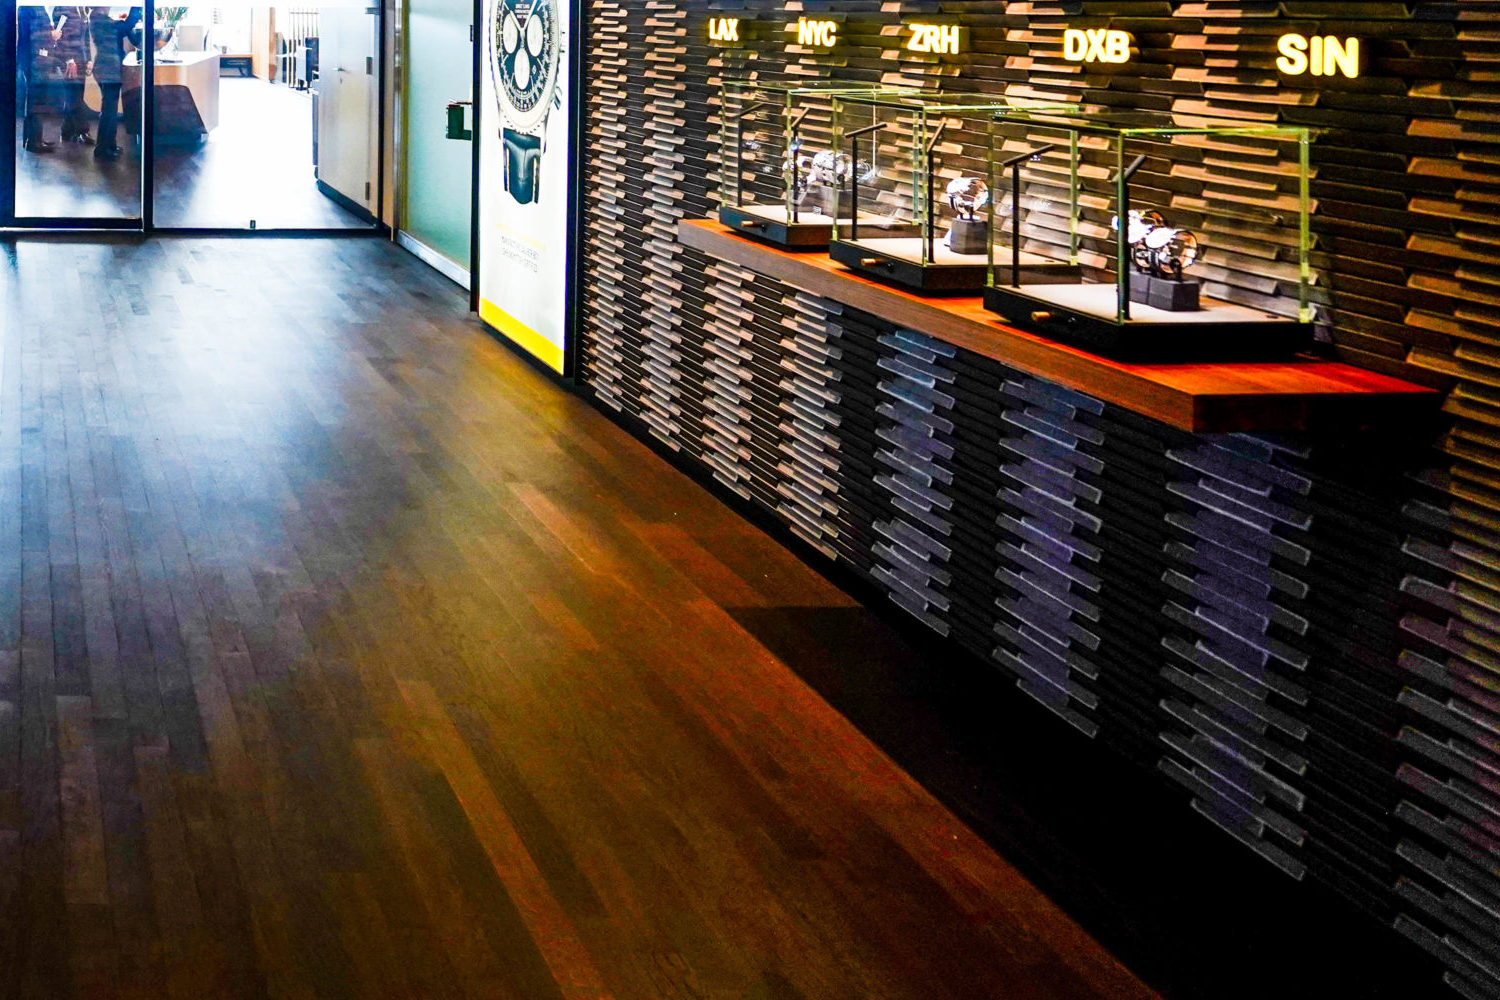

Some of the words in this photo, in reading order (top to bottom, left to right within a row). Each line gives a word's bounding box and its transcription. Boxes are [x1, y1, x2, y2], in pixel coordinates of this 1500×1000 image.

[708, 18, 739, 42] LAX
[797, 18, 838, 47] NYC
[907, 23, 960, 55] ZRH
[1063, 28, 1130, 64] DXB
[1275, 32, 1360, 79] SIN
